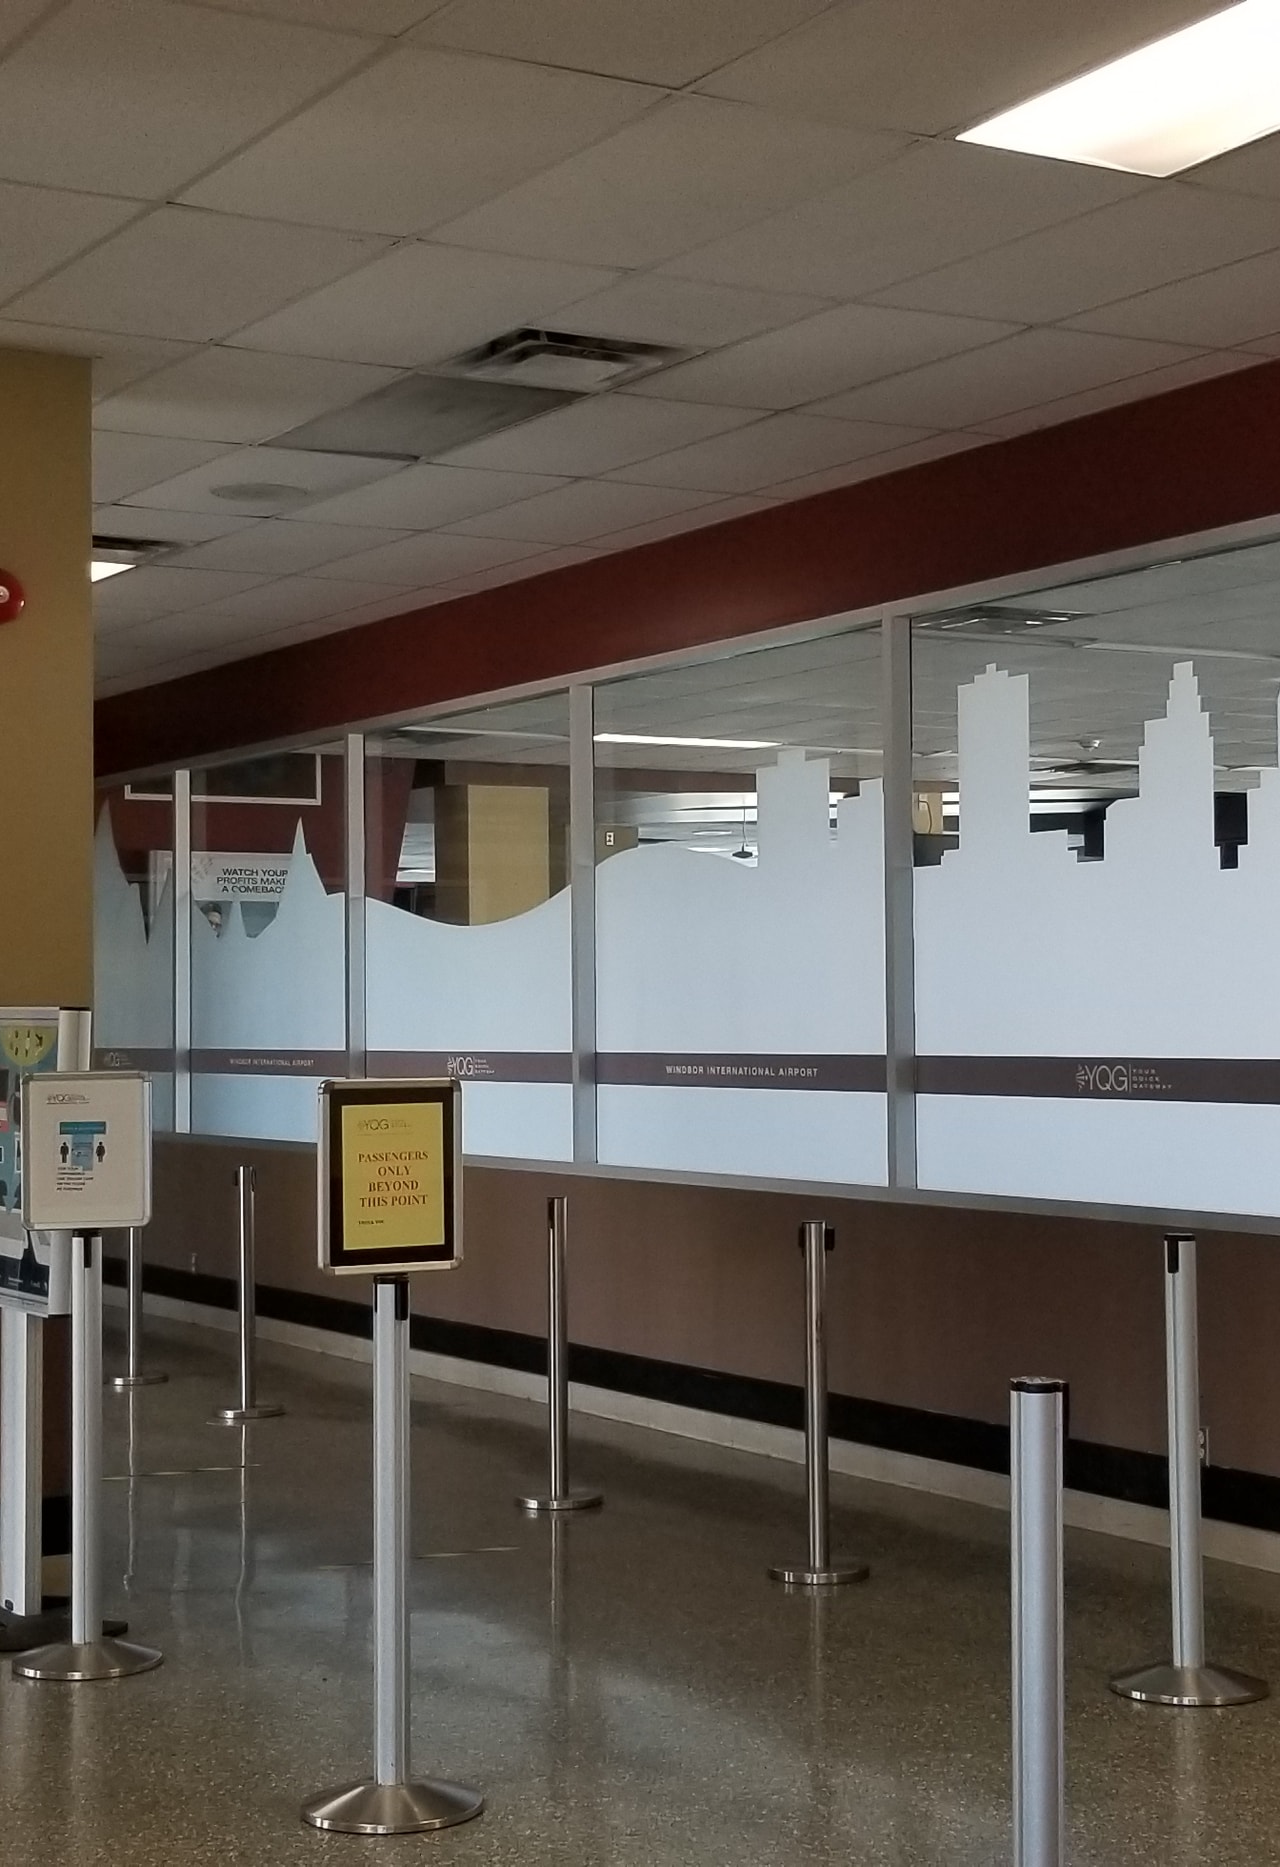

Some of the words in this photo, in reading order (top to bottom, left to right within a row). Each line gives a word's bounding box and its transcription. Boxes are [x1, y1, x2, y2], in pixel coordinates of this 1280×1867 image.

[222, 868, 259, 876] WATCH
[216, 876, 258, 885] PROFITS
[260, 877, 286, 885] MAK
[222, 885, 229, 893] A
[231, 885, 285, 893] COMEBAC
[451, 1056, 473, 1075] YQG
[665, 1065, 704, 1074] WINDSOR
[707, 1066, 775, 1076] INTERNATIONAL
[778, 1067, 818, 1078] AIRPORT
[1084, 1065, 1128, 1092] YQG
[358, 1150, 429, 1163] PASSENGERS
[377, 1165, 411, 1177] ONLY
[368, 1180, 419, 1192] BEYOND
[360, 1196, 388, 1208] THIS
[391, 1194, 428, 1206] POINT
